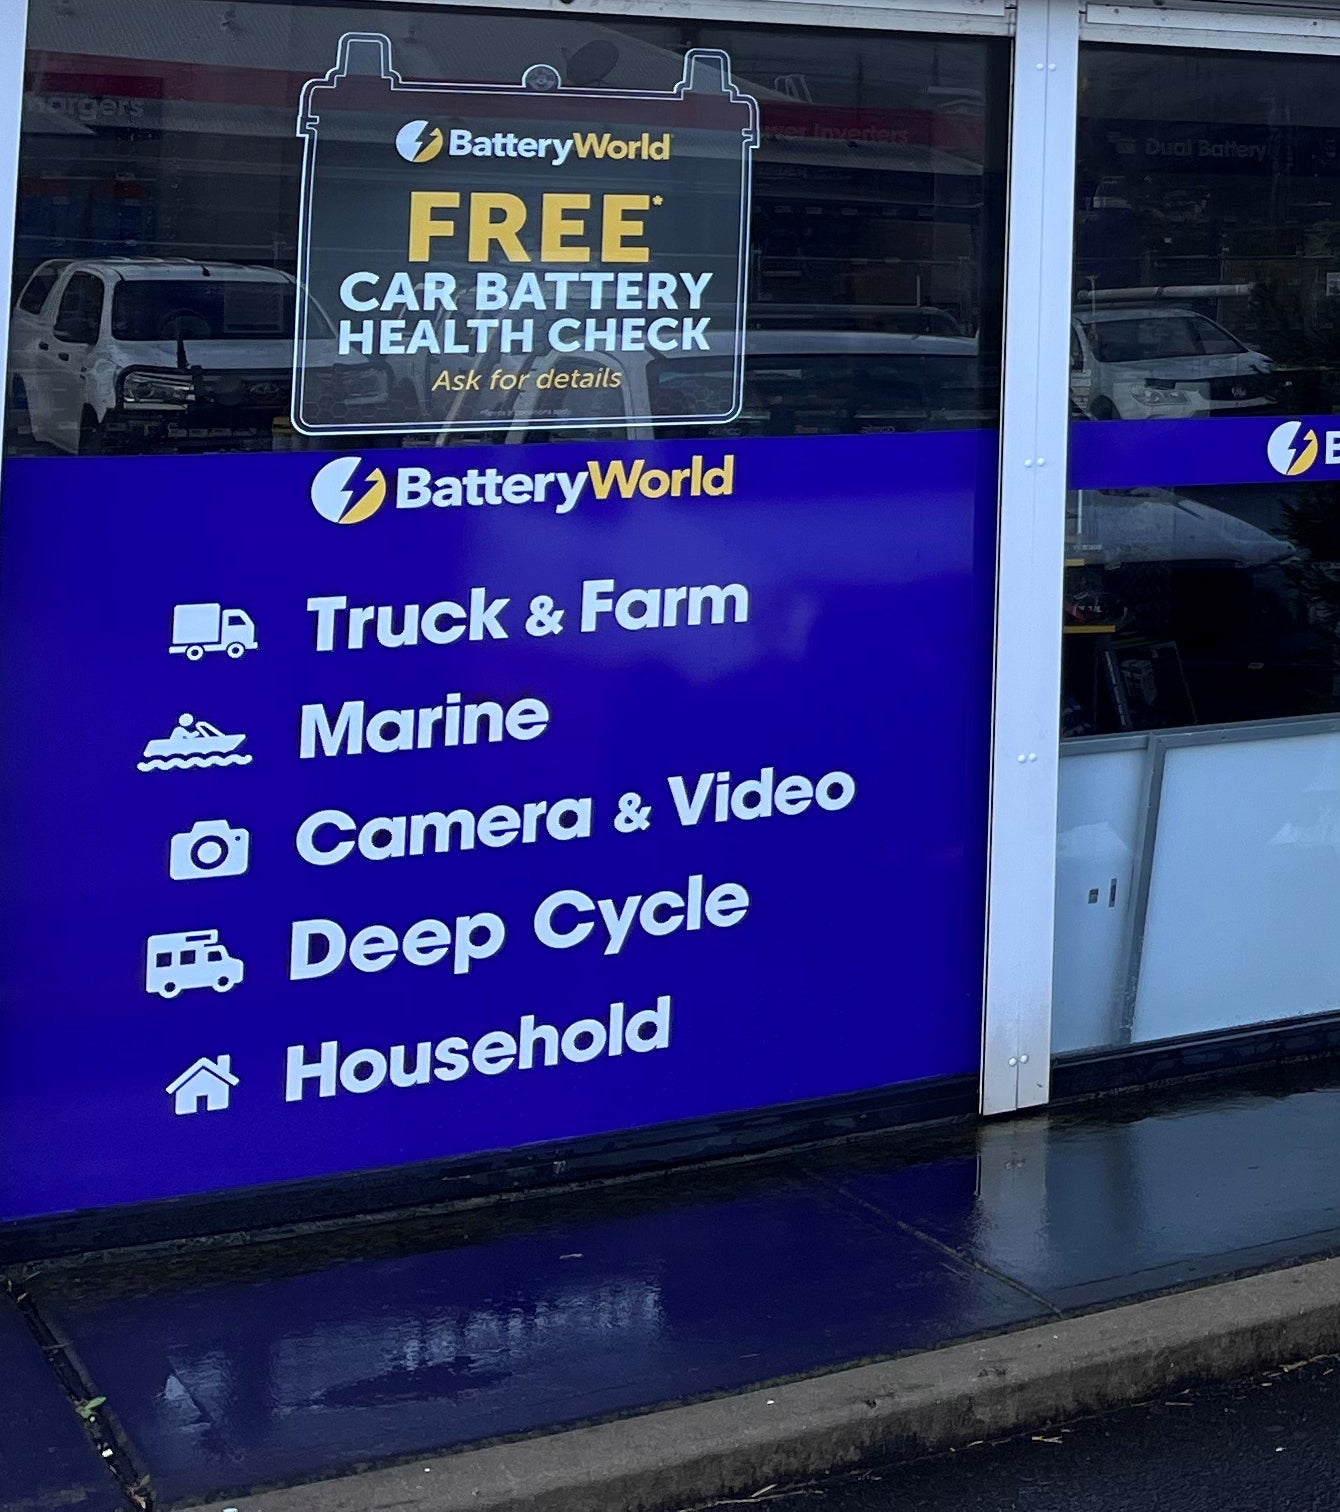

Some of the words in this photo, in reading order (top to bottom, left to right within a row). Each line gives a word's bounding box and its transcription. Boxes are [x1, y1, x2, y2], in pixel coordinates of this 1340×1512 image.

[339, 270, 458, 312] CAR
[475, 271, 714, 312] BATTERY
[338, 318, 535, 355] HEALTH
[548, 316, 712, 352] CHECK
[431, 368, 481, 392] Ask
[488, 368, 528, 393] for
[535, 366, 622, 390] details
[395, 454, 735, 515] BatteryWorld
[306, 586, 511, 653] Truck
[525, 593, 565, 637] &
[580, 578, 750, 634] Farm
[298, 691, 550, 760] Marine
[295, 795, 592, 867] Camera
[613, 791, 652, 834] &
[668, 765, 856, 827] Video
[288, 909, 507, 981] Deep
[533, 874, 751, 956] Cycle
[284, 995, 673, 1102] Household
